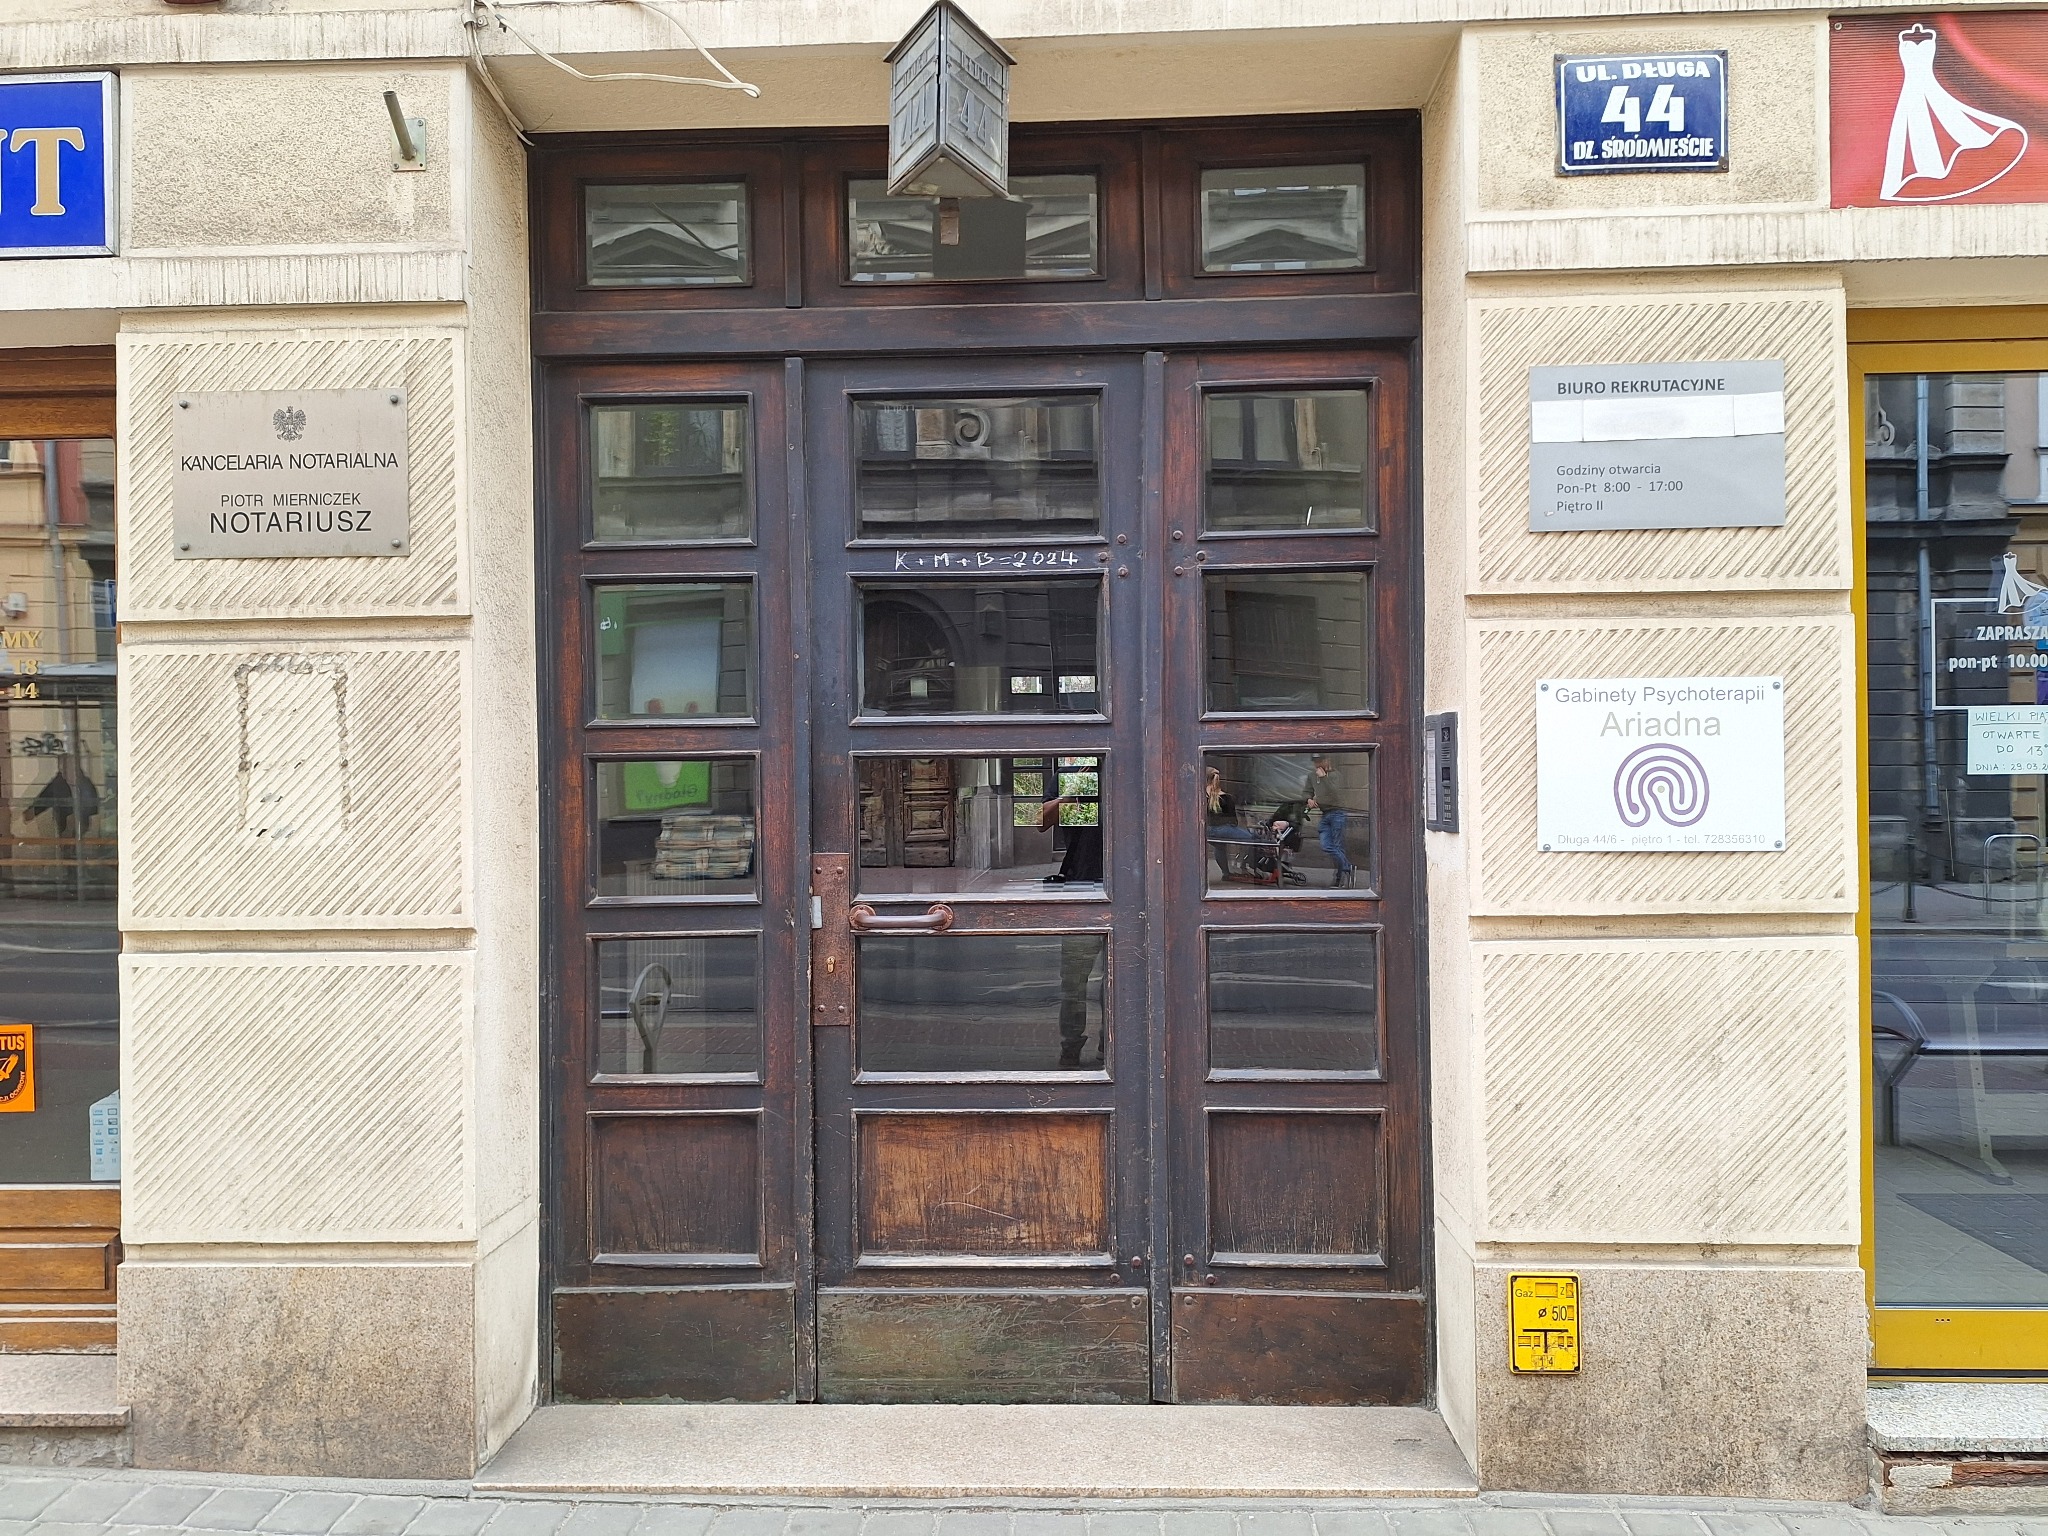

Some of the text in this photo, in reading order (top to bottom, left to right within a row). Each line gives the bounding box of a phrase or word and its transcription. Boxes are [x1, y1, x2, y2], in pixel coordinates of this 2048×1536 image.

[1576, 60, 1711, 83] UL. DŁUGA
[1600, 84, 1685, 133] 44
[1573, 133, 1714, 160] DZ. ŚRÓDMIEŚCIE
[0, 126, 86, 216] T
[1557, 378, 1726, 395] BIURO REKRUTACYJNE
[181, 452, 399, 471] KANCELARIA NOTARIALNA
[1556, 464, 1661, 478] Godziny otwarcia
[1556, 483, 1598, 494] Pon-Pt
[1603, 482, 1631, 493] 8:00
[1649, 480, 1684, 492] 17:00
[221, 492, 361, 507] PIOTR MIERNICZEK
[1556, 501, 1593, 514] Piętro
[210, 510, 372, 533] NOTARIUSZ
[13, 659, 39, 676] 18
[1948, 653, 2048, 673] pon-pt 10.00
[12, 682, 38, 699] 14
[1555, 686, 1765, 705] Gabinety Psychoterapii
[1600, 711, 1721, 737] Ariadna
[1975, 711, 2021, 722] WIELKI
[1982, 730, 2040, 740] OTWARTE
[1996, 744, 2014, 754] DO
[1975, 763, 1999, 771] DNIA
[2010, 762, 2048, 771] 29.03.2
[1593, 834, 1617, 844] 44/6
[1631, 834, 1663, 846] piętro
[1667, 834, 1672, 844] 1
[1704, 834, 1766, 844] 728356310
[1515, 1289, 1533, 1298] Gaz
